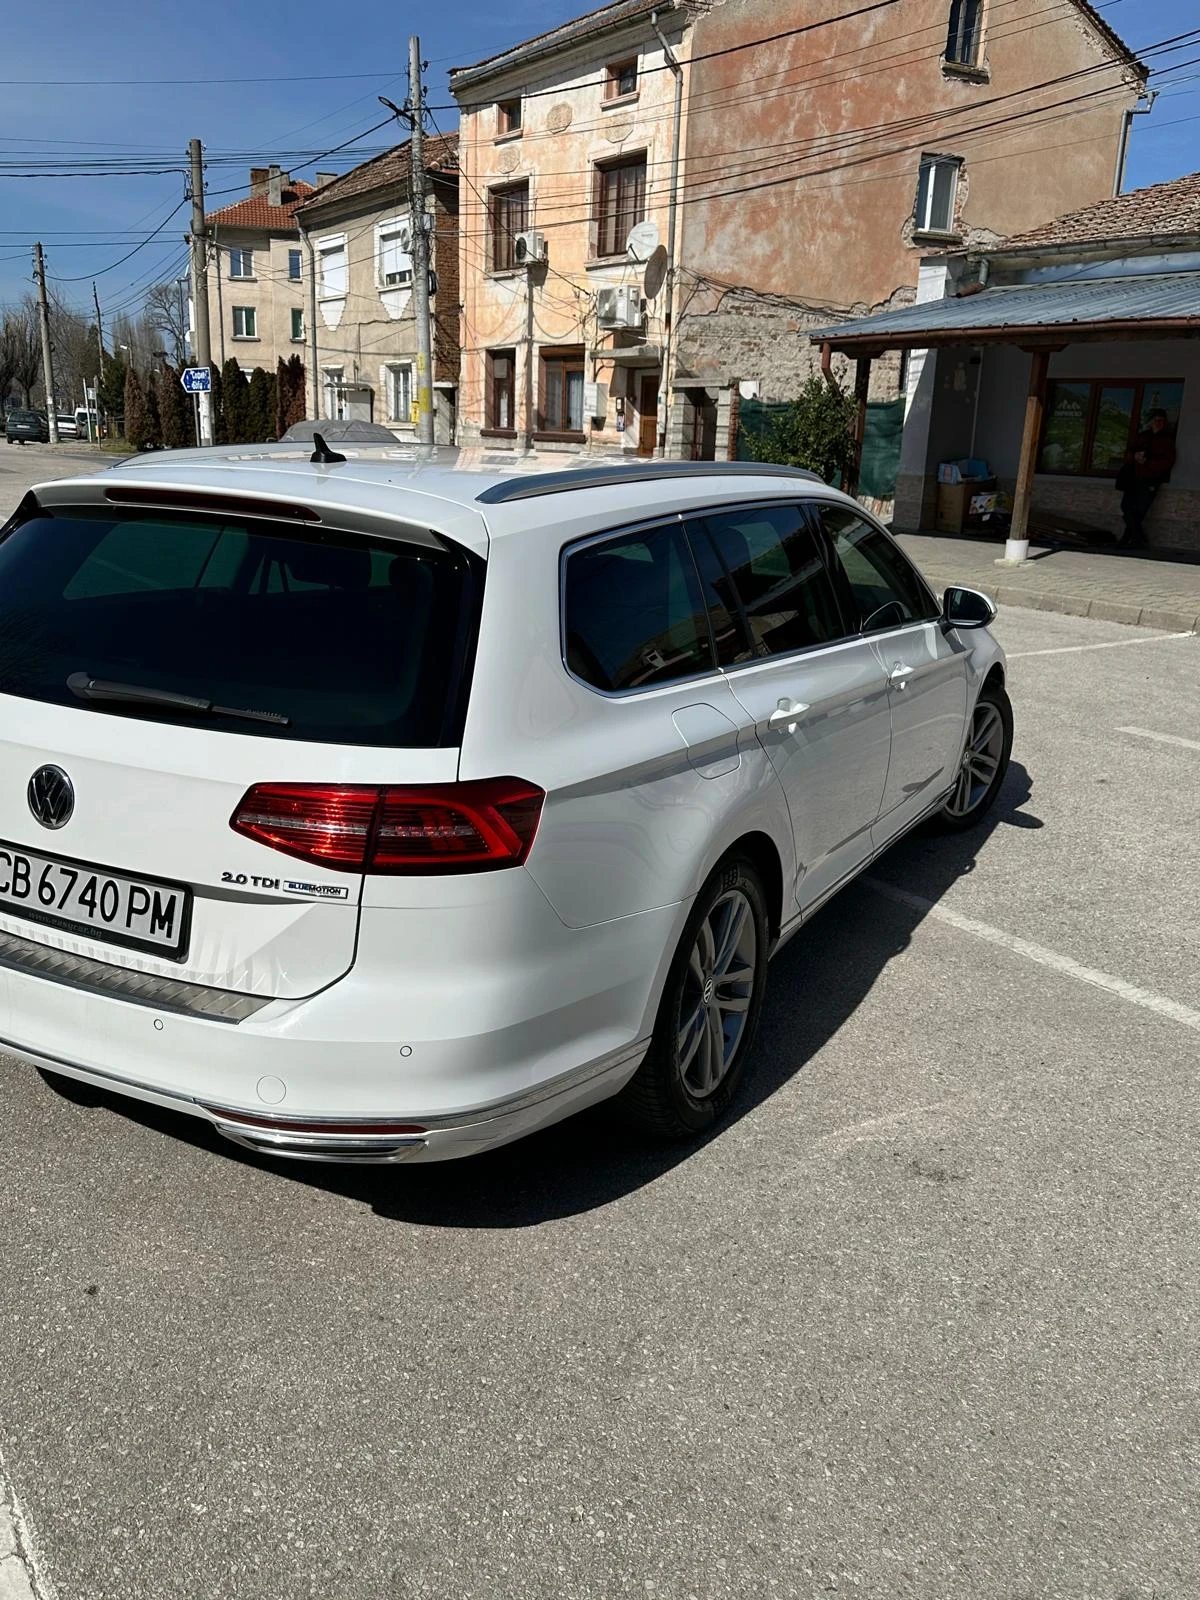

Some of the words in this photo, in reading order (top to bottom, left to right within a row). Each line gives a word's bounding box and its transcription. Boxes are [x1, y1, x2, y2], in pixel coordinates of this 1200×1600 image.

[221, 871, 248, 885] 2.0
[250, 875, 281, 890] TDI
[288, 882, 341, 895] BLUEMOTION
[38, 864, 119, 922] 6740
[125, 885, 177, 939] PM
